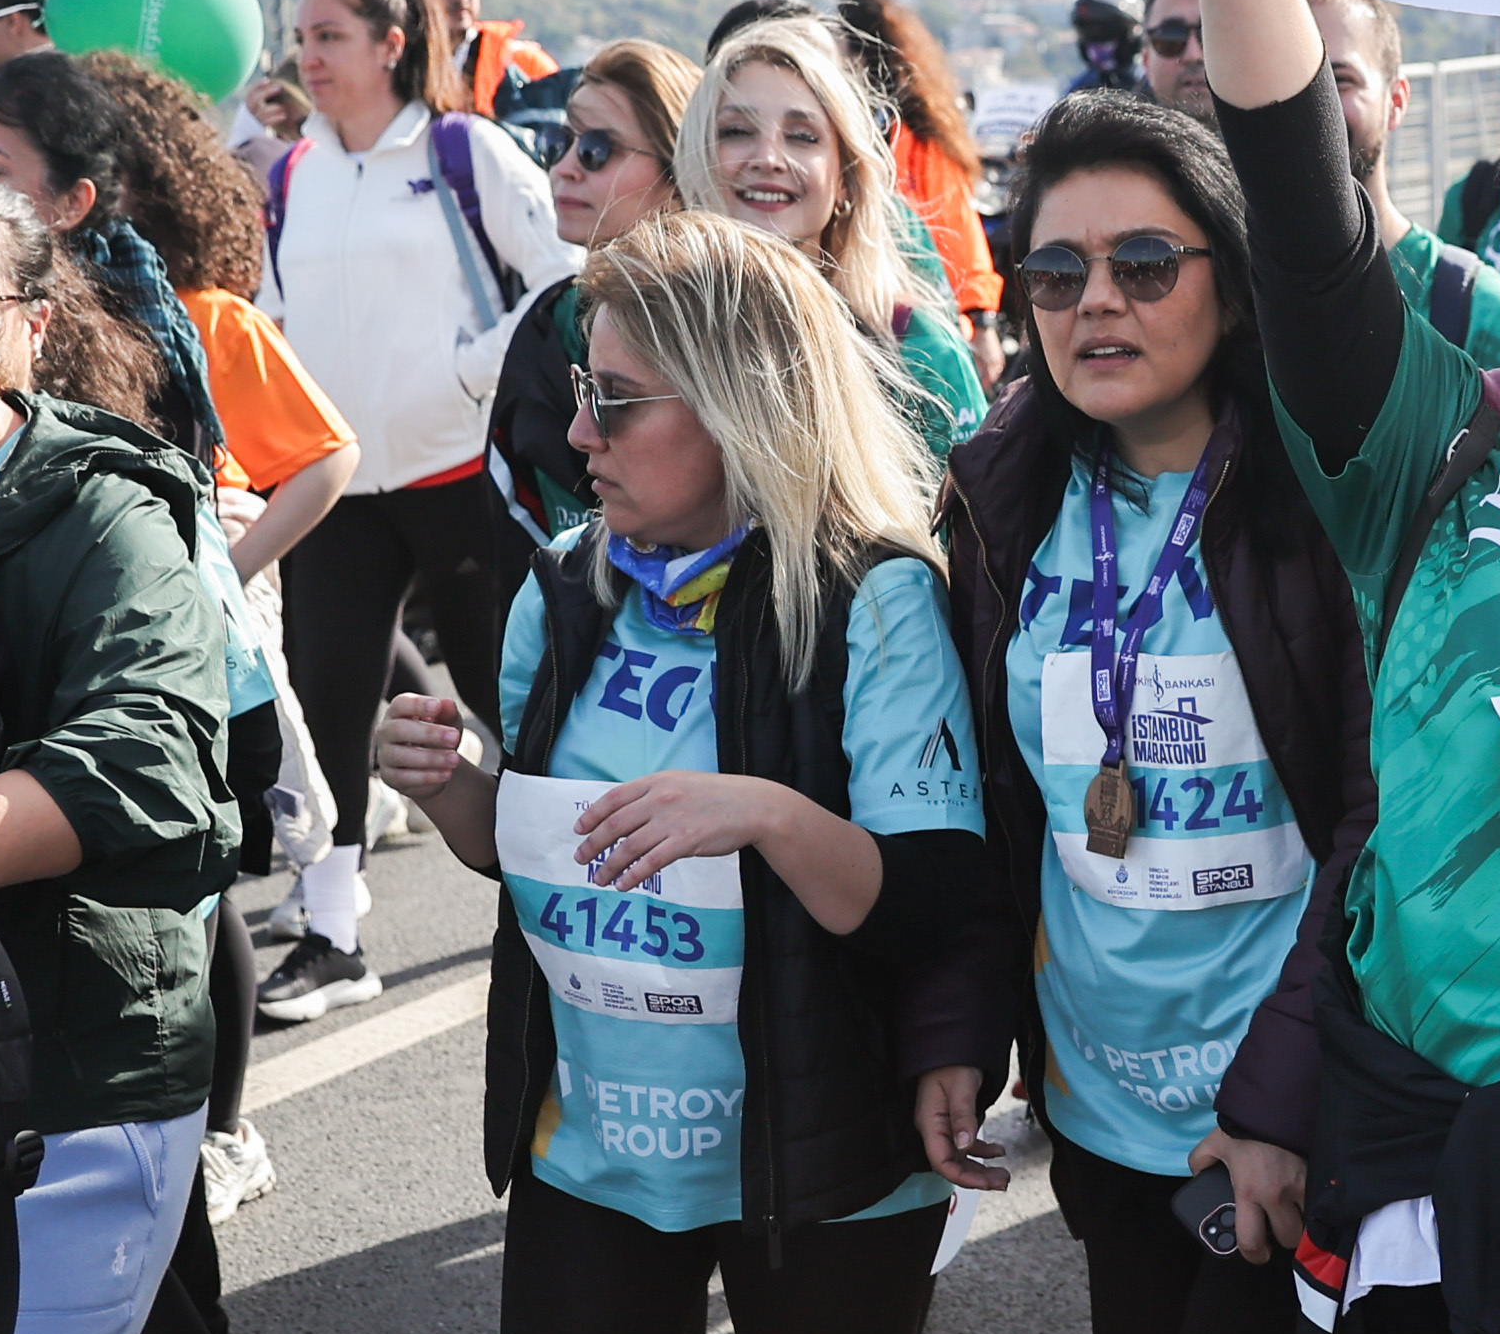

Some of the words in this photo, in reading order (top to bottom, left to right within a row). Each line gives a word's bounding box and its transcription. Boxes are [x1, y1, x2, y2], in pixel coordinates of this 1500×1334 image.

[1164, 678, 1215, 689] BANKASI
[1131, 713, 1205, 743] İSTANBUL
[1132, 740, 1207, 765] MARATONU
[1132, 770, 1264, 831] 1424
[1196, 866, 1249, 885] SPOR
[539, 891, 705, 963] 41453
[648, 995, 698, 1007] SPOR
